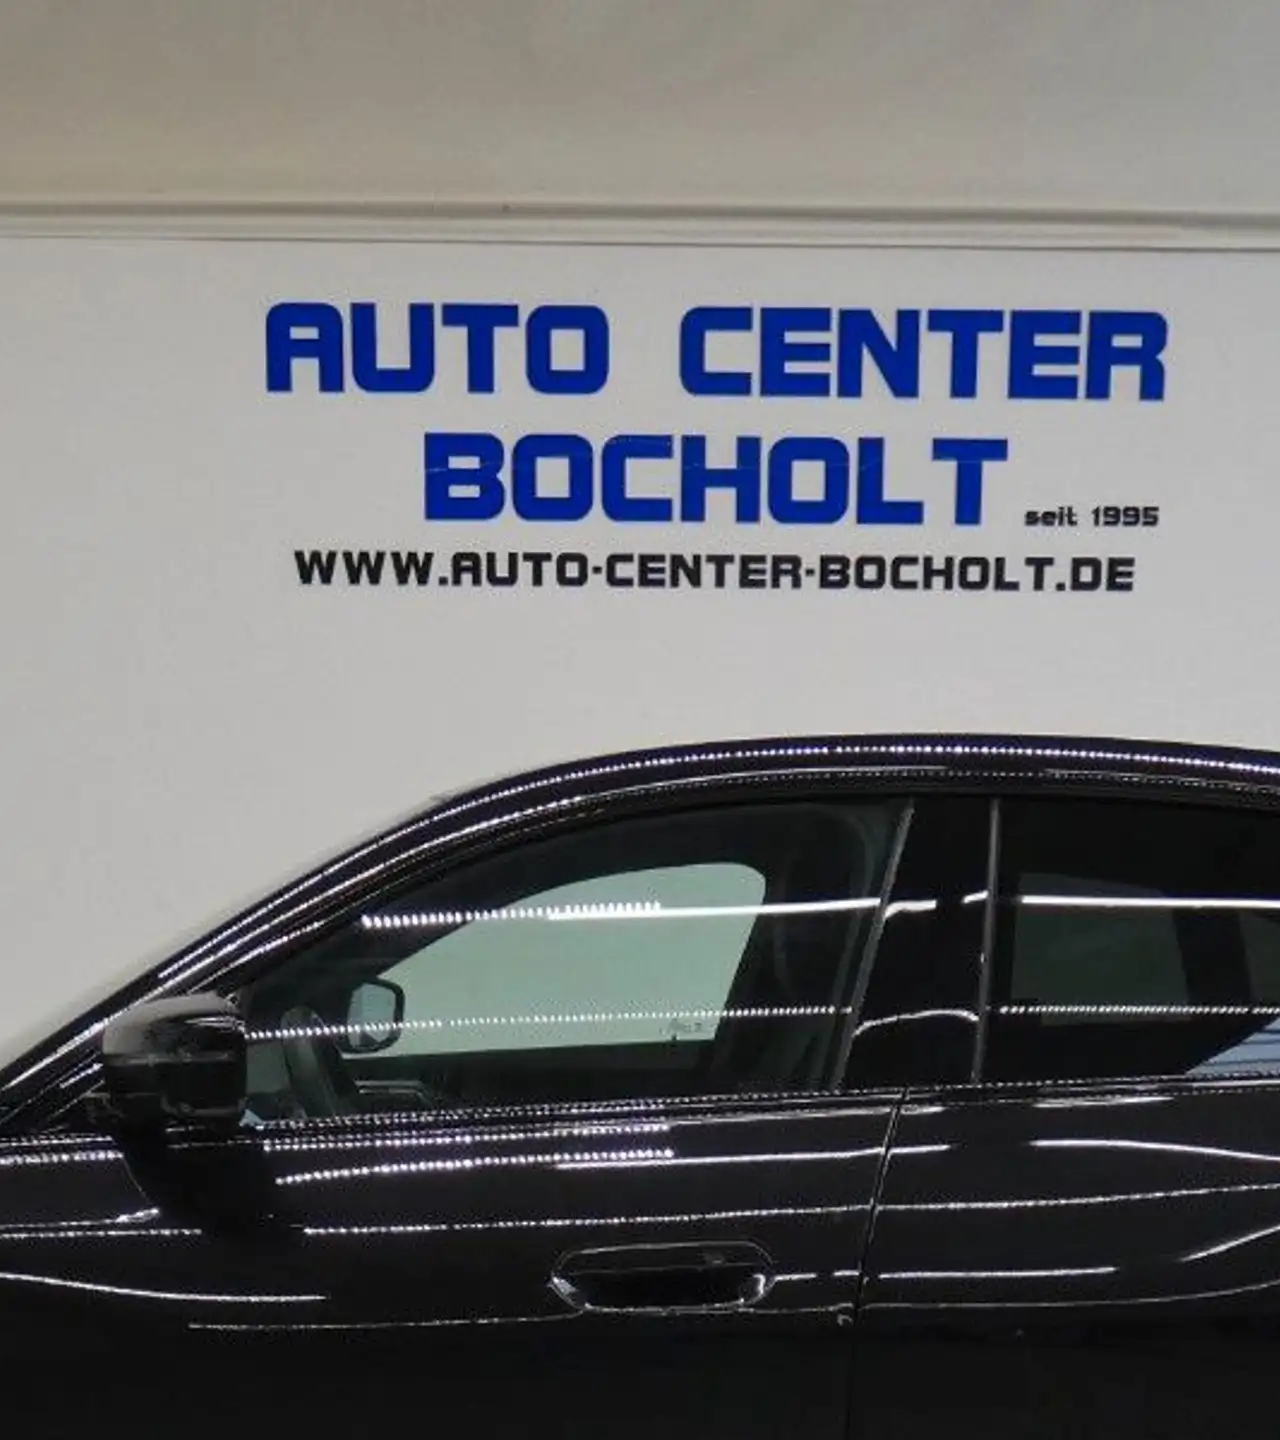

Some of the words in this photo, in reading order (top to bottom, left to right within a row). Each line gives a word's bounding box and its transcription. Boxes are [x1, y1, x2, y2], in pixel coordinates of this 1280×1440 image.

[266, 301, 611, 397] AUTO
[679, 306, 1169, 403] CENTER
[424, 430, 1010, 528] BOCHOLT
[1024, 505, 1078, 527] seit
[1091, 505, 1160, 528] 1995
[293, 549, 1136, 593] WWW.AUTO-CENTER-BOCHOLT.DE
